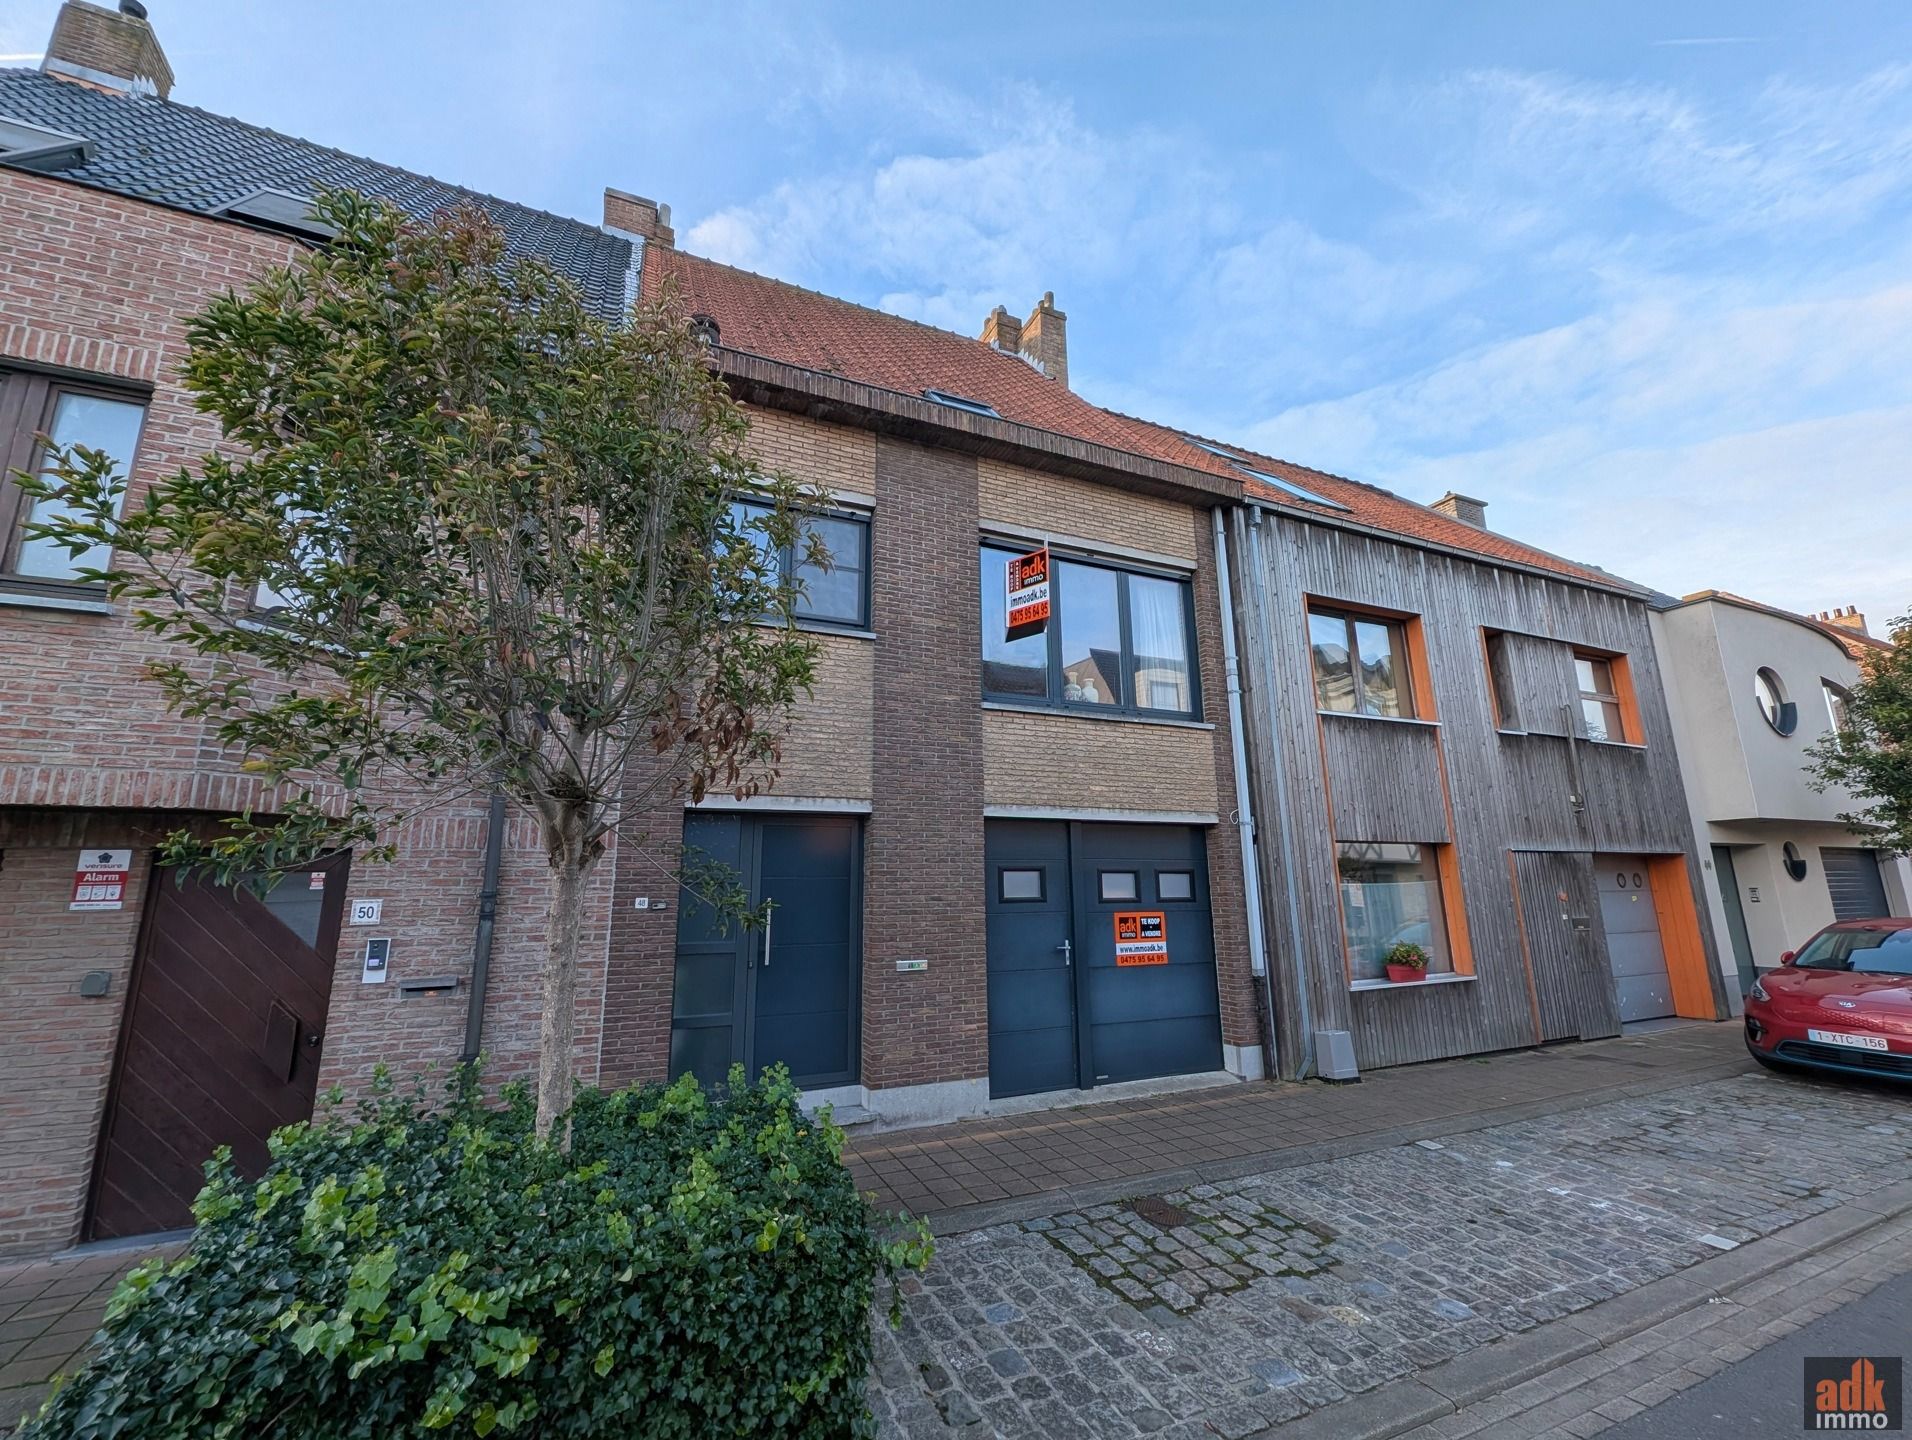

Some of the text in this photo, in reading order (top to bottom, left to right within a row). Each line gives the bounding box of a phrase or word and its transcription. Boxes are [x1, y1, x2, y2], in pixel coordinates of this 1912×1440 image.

[1022, 556, 1045, 578] adk
[1023, 574, 1043, 585] immo
[1010, 587, 1047, 607] immoadk.be
[1011, 601, 1049, 623] 0475 95 64 95
[83, 872, 119, 882] Alarm
[358, 906, 374, 918] 50
[1120, 918, 1136, 932] adk
[1120, 944, 1163, 953] www.immoadk.be
[1120, 956, 1136, 964] 0475
[1147, 955, 1155, 963] 64
[1157, 954, 1165, 962] 95
